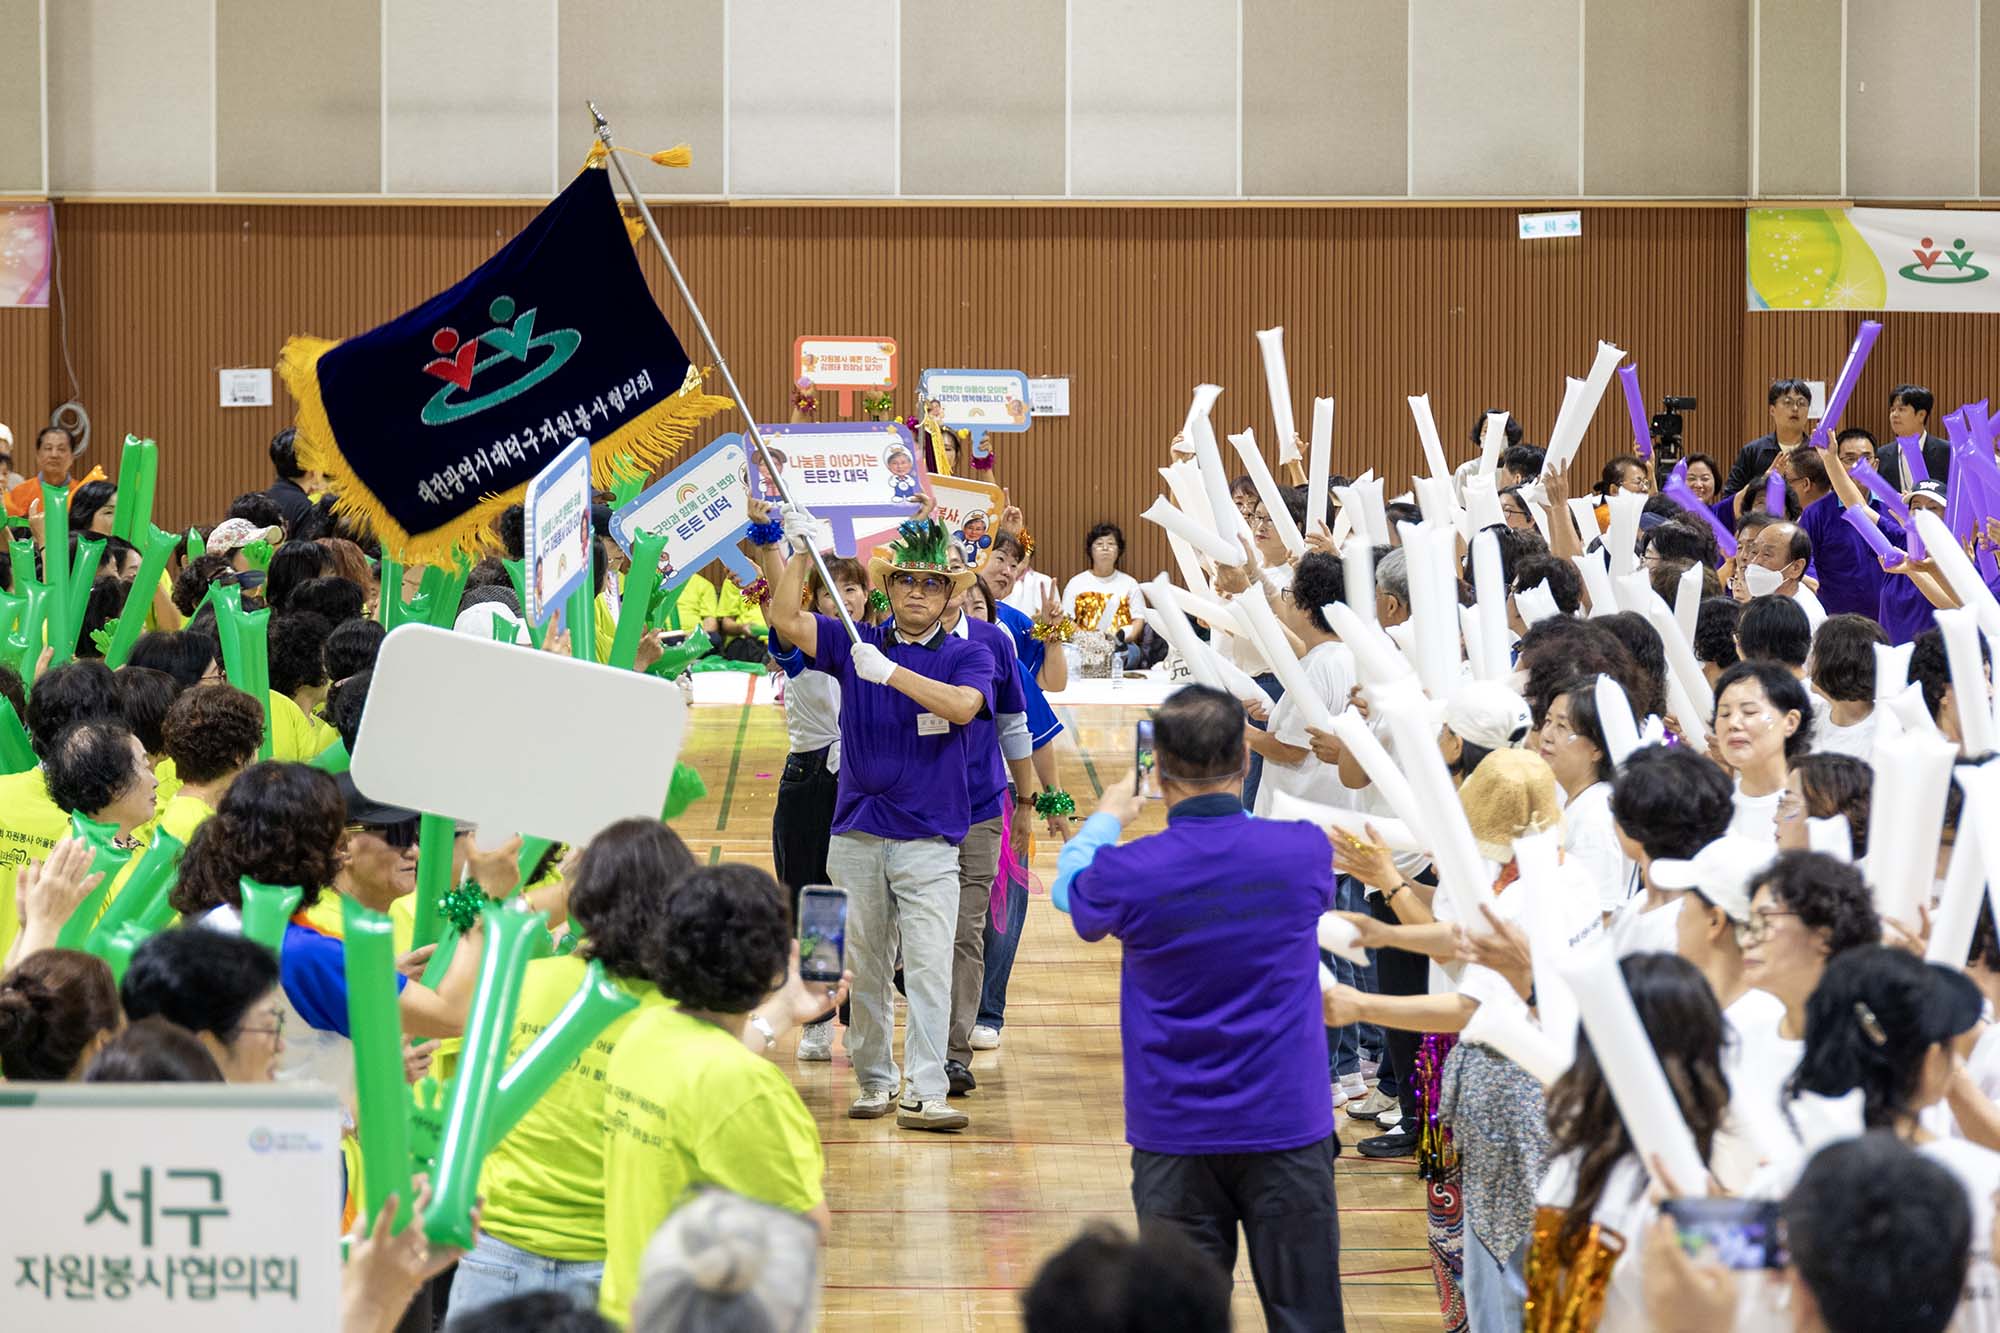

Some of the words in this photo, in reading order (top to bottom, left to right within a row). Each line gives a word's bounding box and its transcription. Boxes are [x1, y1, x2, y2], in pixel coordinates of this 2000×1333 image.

[789, 454, 826, 469] 나눔을
[829, 453, 879, 468] 이어가는
[804, 469, 841, 484] 든든한
[844, 468, 869, 482] 대덕
[696, 493, 709, 505] 더
[706, 486, 719, 498] 큰
[716, 473, 736, 490] 변화
[676, 514, 706, 541] 든든
[702, 495, 732, 521] 대덕
[5, 829, 34, 845] 자원봉사
[83, 1165, 231, 1248] 서구
[14, 1252, 299, 1302] 자원봉사협의회
